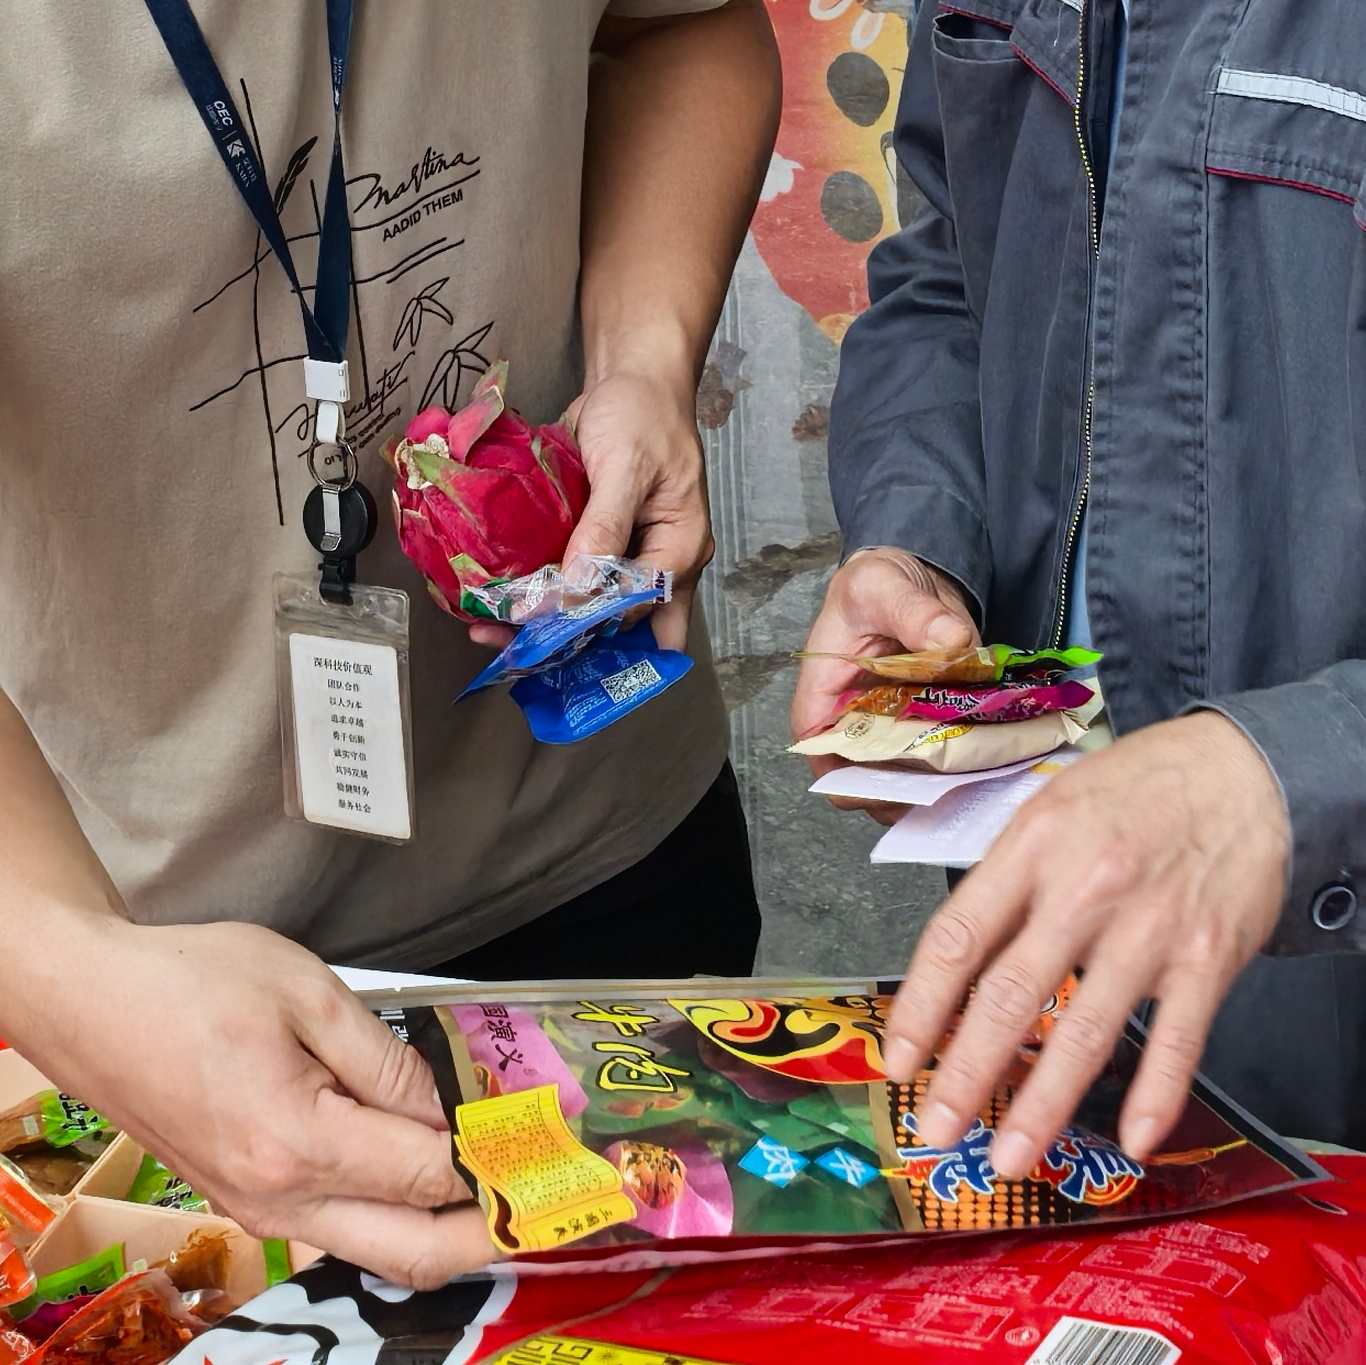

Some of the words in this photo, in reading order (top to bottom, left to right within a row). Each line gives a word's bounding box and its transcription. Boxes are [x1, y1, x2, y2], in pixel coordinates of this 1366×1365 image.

[213, 100, 234, 127] CEC
[382, 208, 422, 242] AADID
[422, 188, 464, 218] THEM
[313, 656, 373, 676] 深科技价值观
[327, 678, 360, 693] 团队合作
[329, 696, 363, 711] 以人为本
